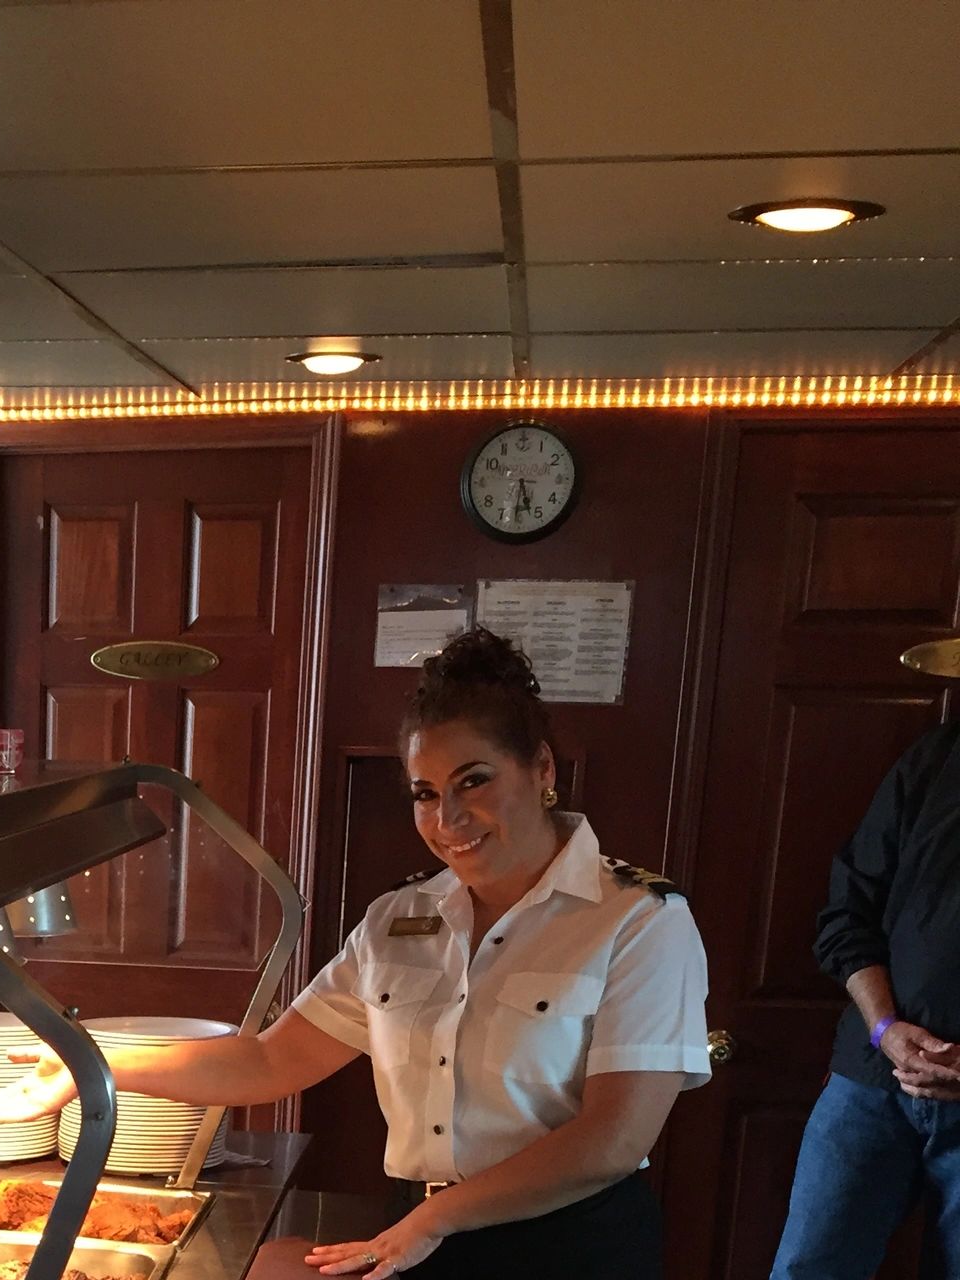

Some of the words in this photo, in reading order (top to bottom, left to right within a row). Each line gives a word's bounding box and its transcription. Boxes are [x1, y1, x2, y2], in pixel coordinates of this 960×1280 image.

[486, 457, 499, 471] 10
[550, 453, 560, 466] 2
[484, 494, 494, 508] 8
[548, 491, 558, 505] 4
[497, 507, 506, 521] 7
[534, 506, 543, 519] 5
